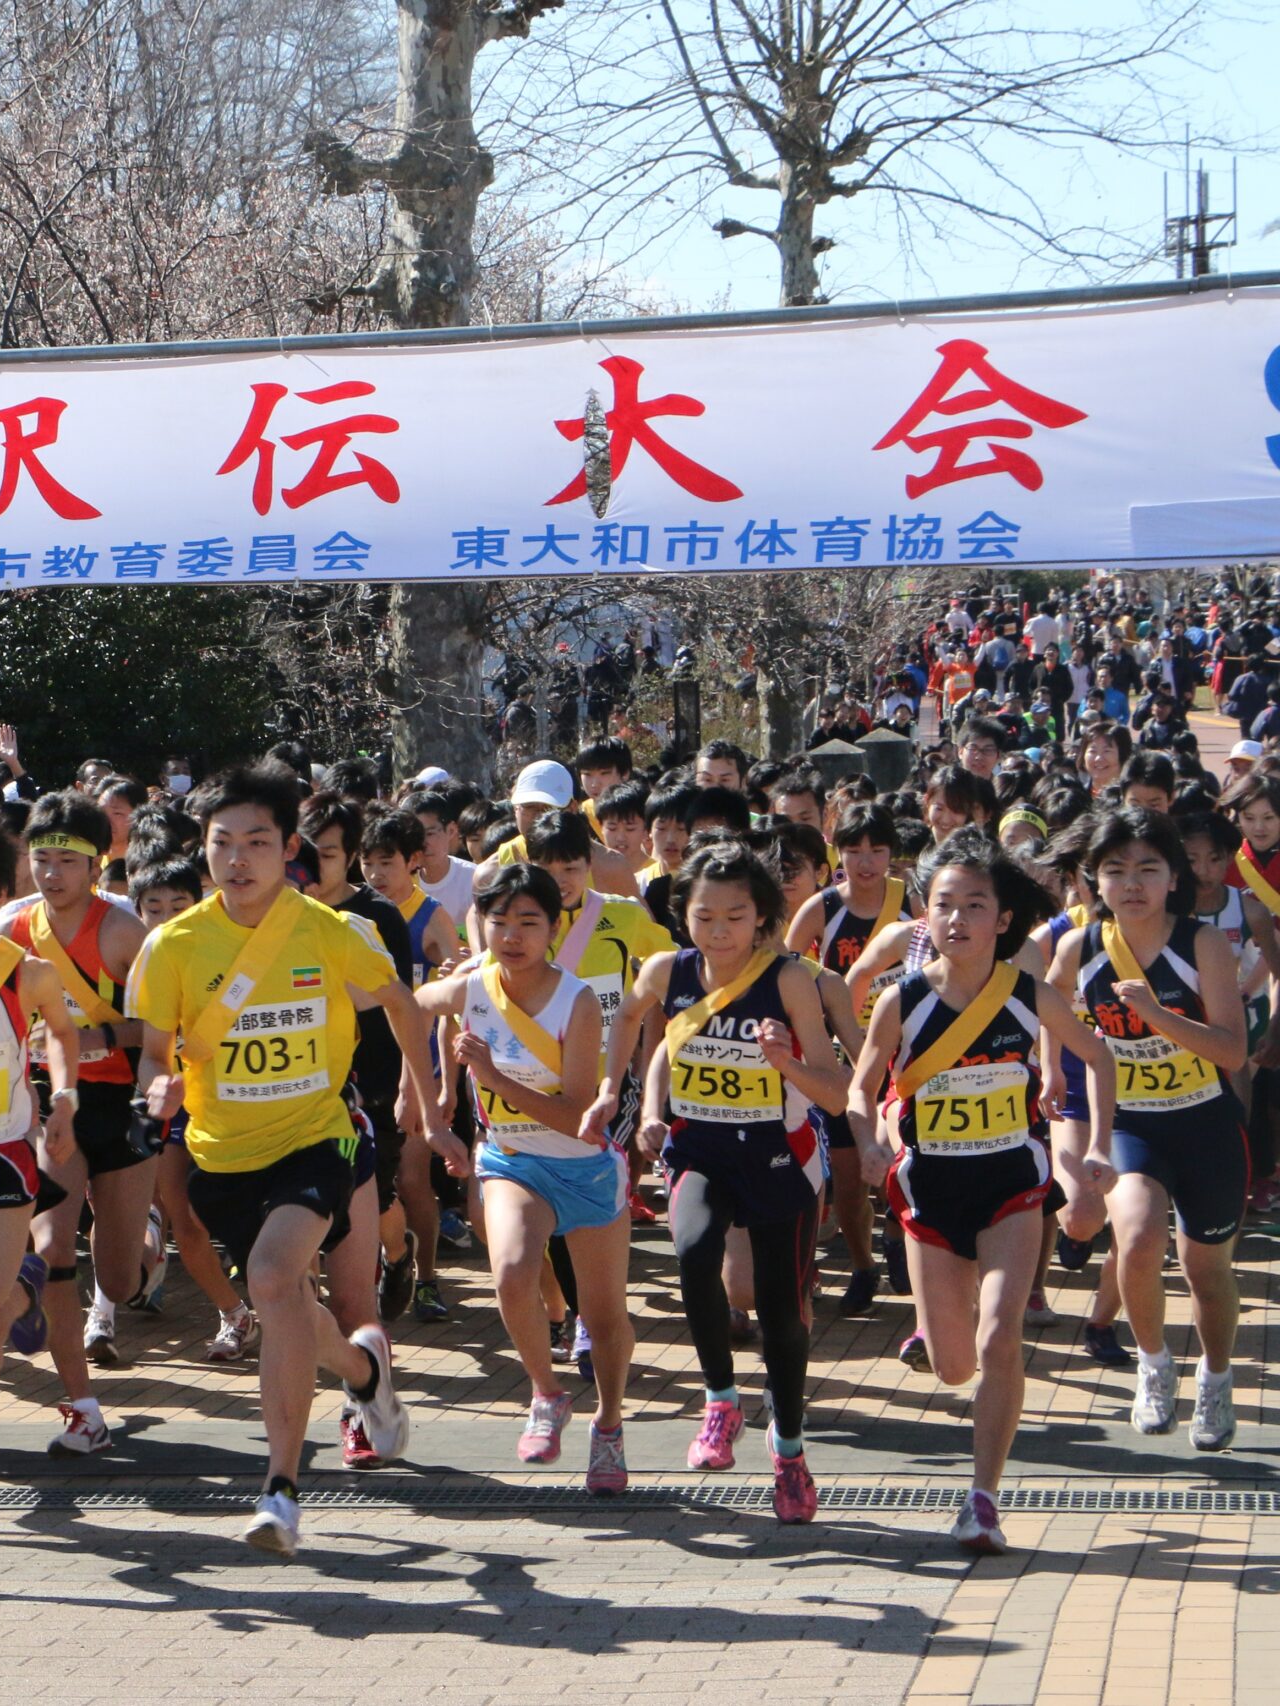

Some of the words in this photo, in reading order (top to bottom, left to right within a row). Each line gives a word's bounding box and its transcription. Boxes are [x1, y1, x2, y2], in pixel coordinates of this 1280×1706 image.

[450, 510, 1022, 570] 東大和市体育協会
[220, 1037, 317, 1075] 703-1
[1118, 1056, 1205, 1092] 752-1
[677, 1062, 769, 1100] 758-1
[924, 1095, 1017, 1132] 751-1
